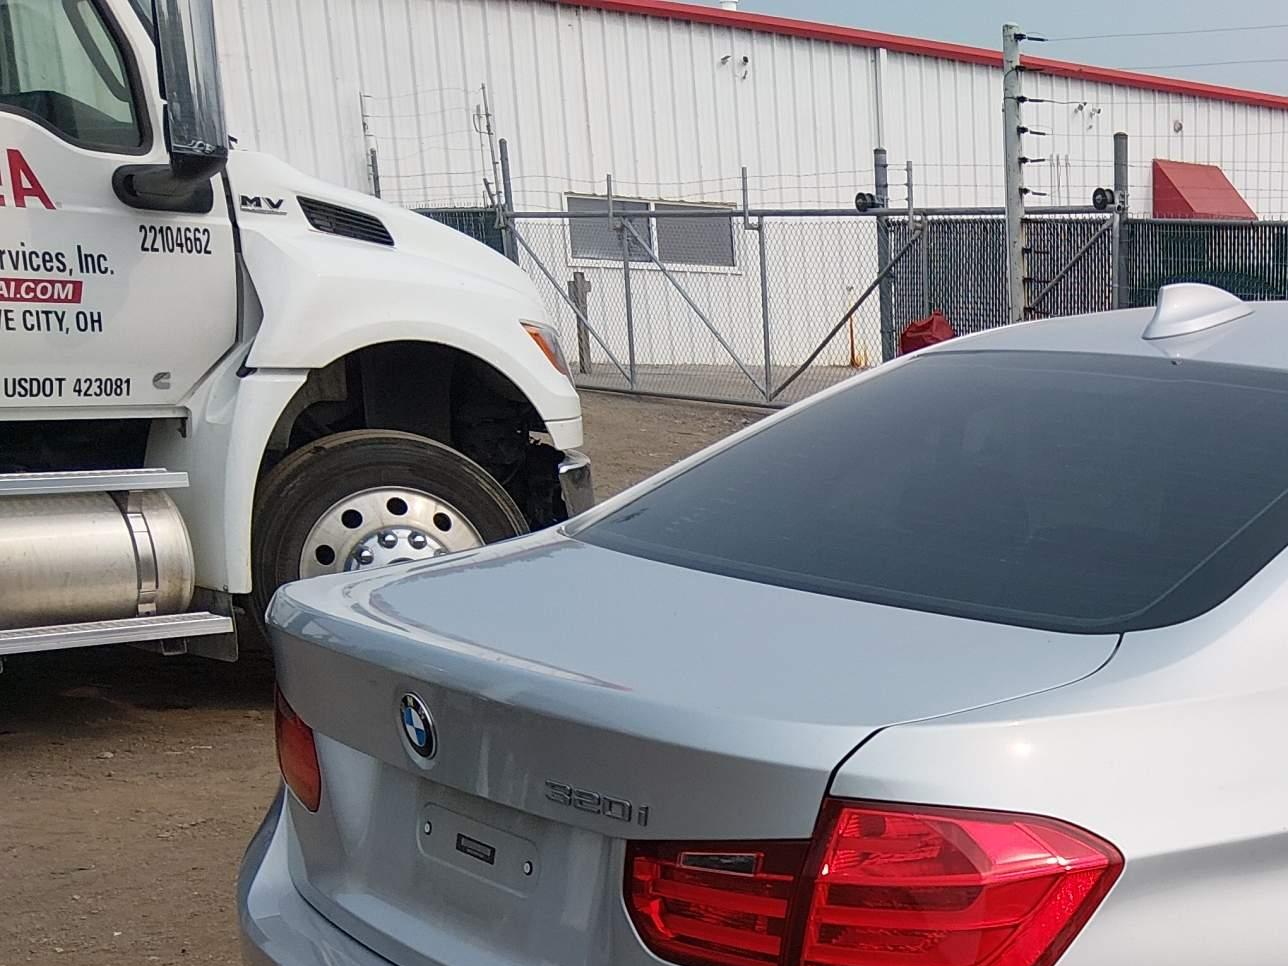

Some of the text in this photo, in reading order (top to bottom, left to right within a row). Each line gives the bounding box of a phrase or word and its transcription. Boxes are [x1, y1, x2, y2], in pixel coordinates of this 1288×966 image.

[0, 148, 56, 210] A
[240, 195, 285, 210] MV
[139, 224, 212, 255] 22104662
[77, 244, 114, 275] Inc.
[22, 309, 70, 335] CITY,
[75, 310, 103, 332] OH
[4, 376, 131, 398] USDOT 423081
[544, 778, 649, 828] 320i
